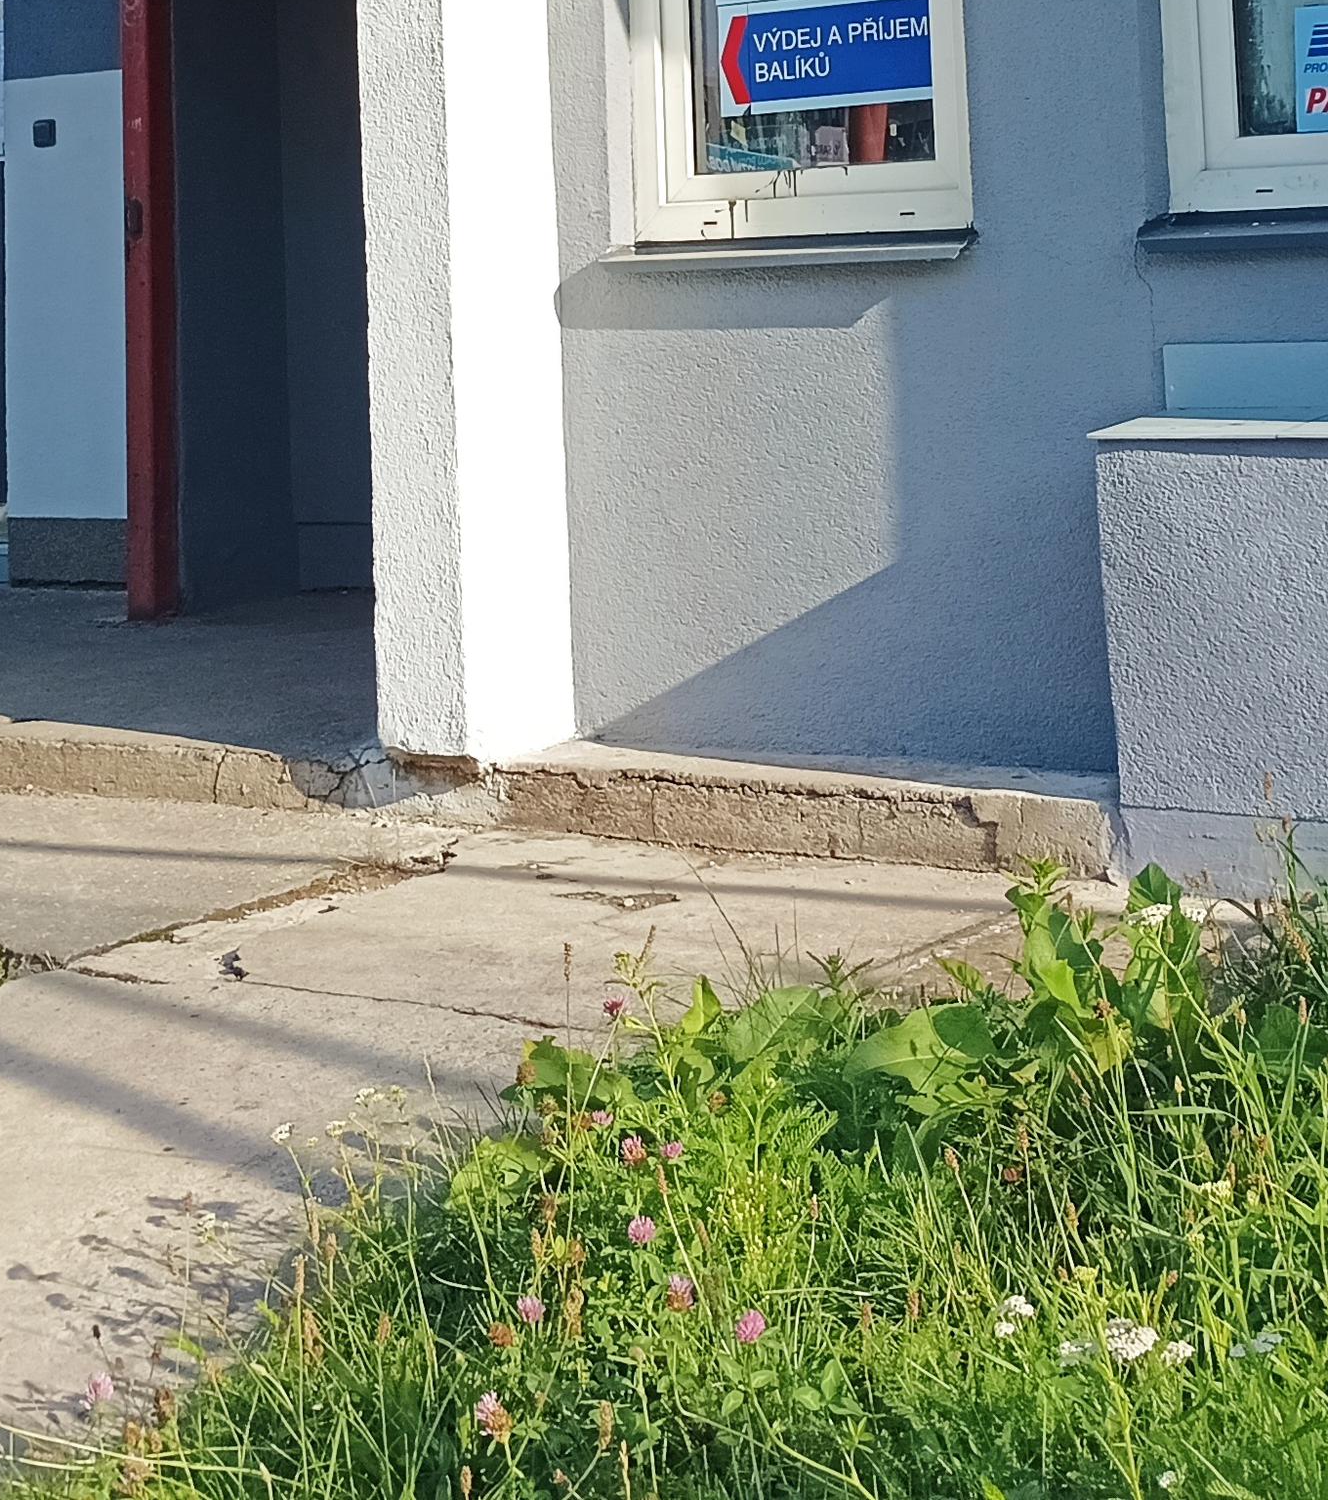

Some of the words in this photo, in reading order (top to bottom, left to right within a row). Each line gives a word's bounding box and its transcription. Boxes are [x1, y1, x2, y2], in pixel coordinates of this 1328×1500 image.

[752, 27, 821, 53] VÝDEJ
[827, 25, 842, 45] A
[848, 16, 929, 44] PŘÍJEM
[755, 51, 830, 83] BALÍKŮ
